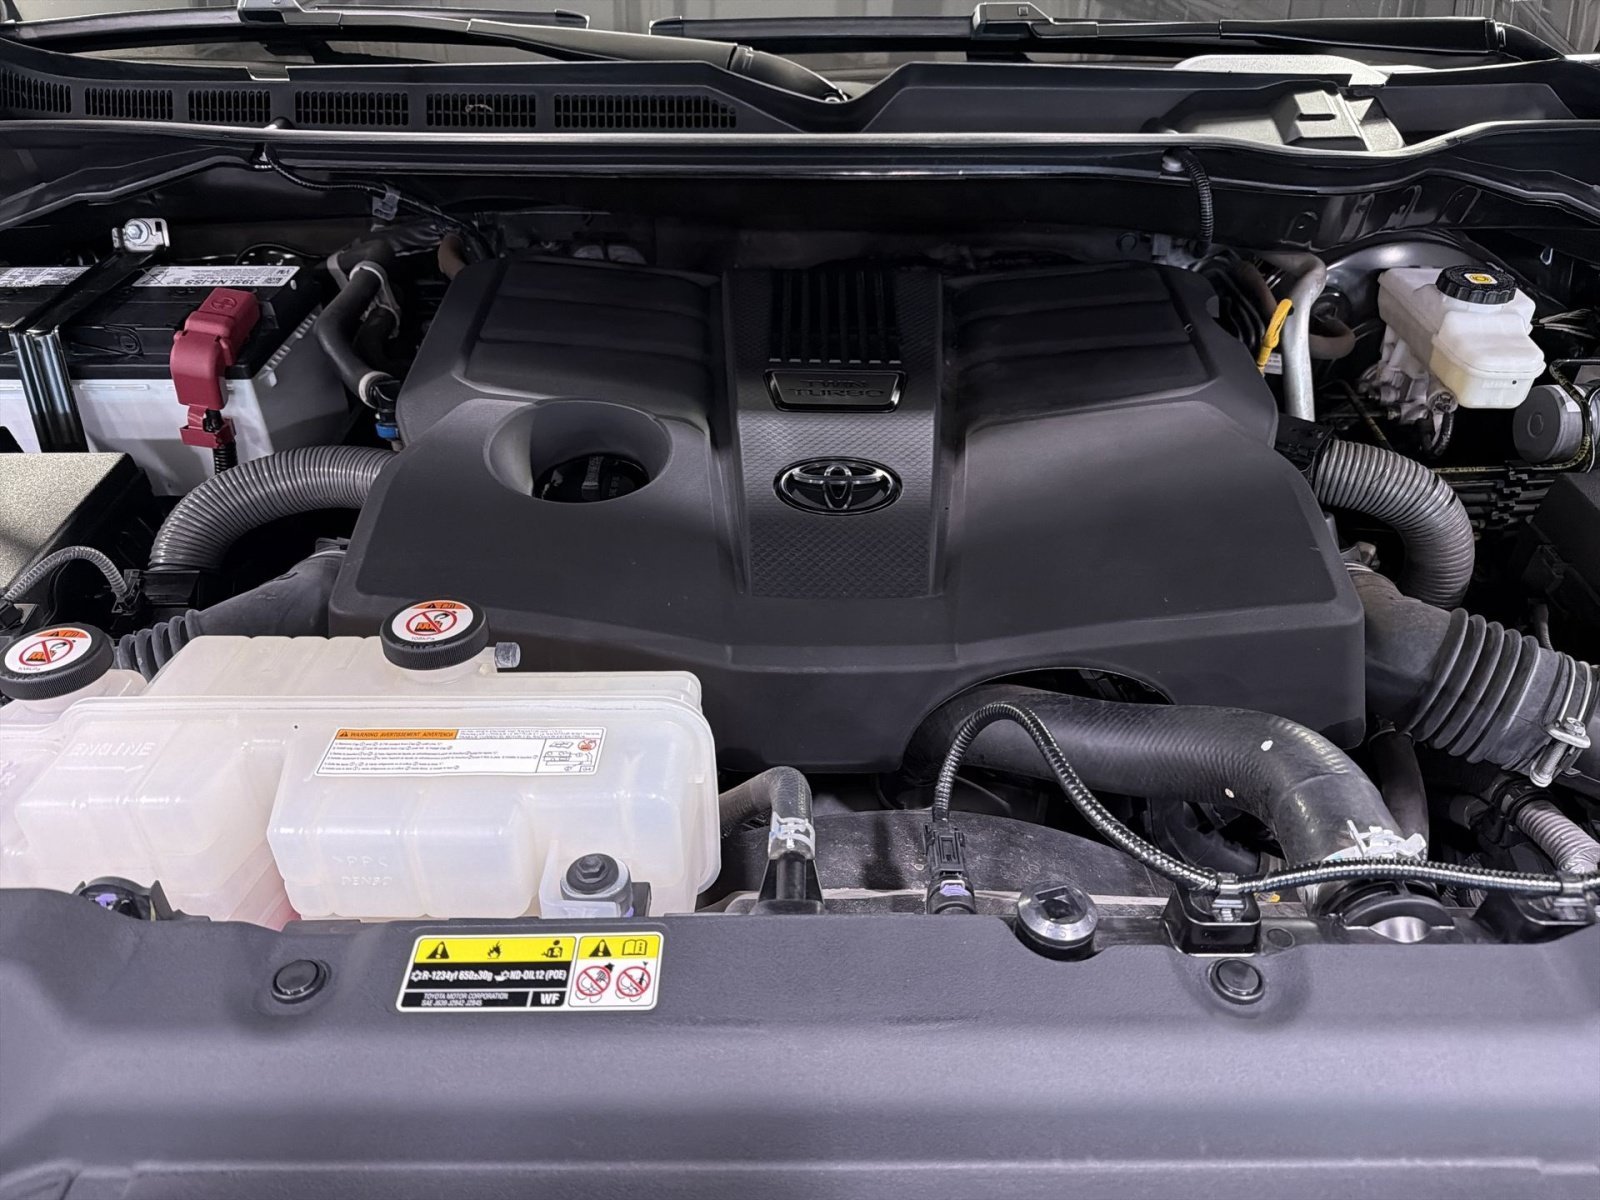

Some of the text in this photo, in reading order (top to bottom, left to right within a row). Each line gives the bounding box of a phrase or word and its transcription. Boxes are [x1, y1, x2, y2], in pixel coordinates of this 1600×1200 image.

[788, 388, 884, 398] TURBO
[422, 970, 458, 982] R-1234yf
[545, 969, 567, 981] (POE)
[468, 992, 509, 1000] CORPORATION
[540, 993, 561, 1005] WF
